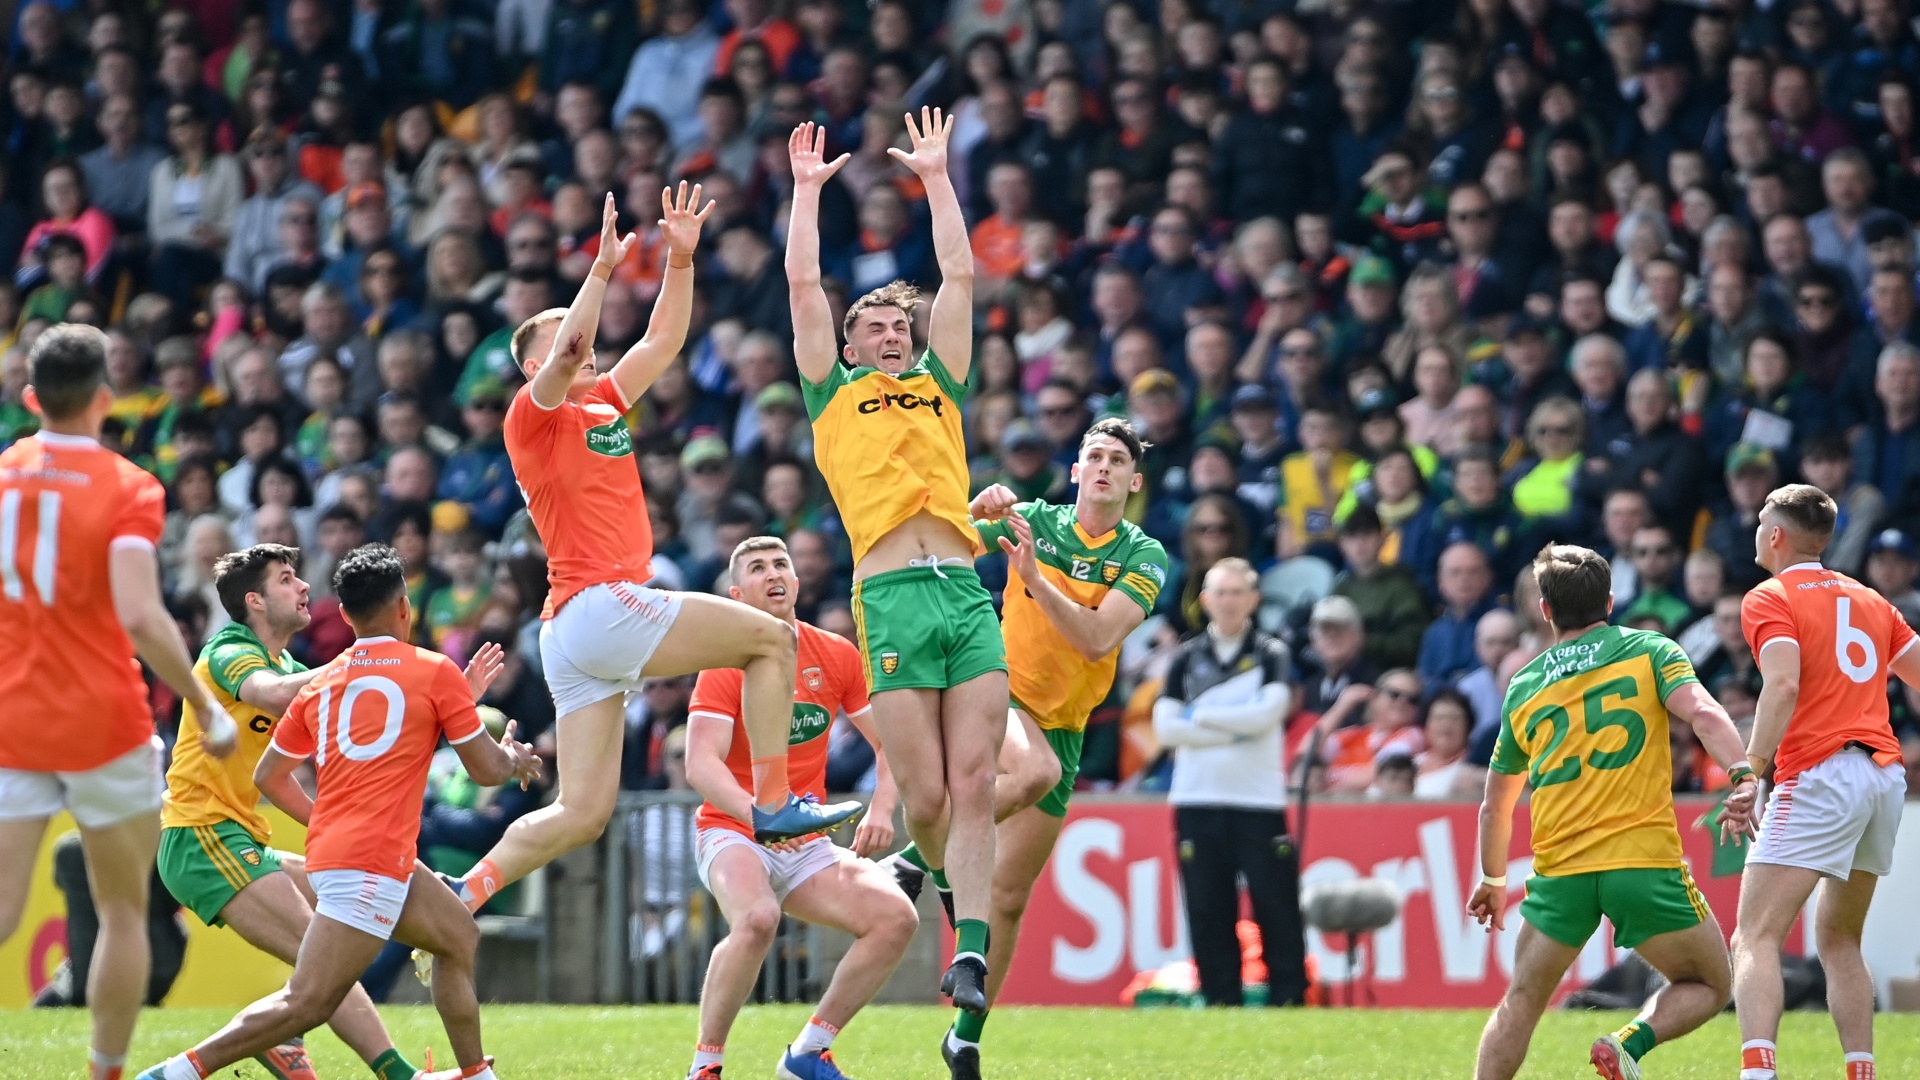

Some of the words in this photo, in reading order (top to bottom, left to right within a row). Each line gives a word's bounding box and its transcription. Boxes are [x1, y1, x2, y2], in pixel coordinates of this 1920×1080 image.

[1071, 560, 1091, 580] 12
[1836, 596, 1878, 683] 6
[316, 675, 406, 767] 10
[1525, 676, 1647, 791] 25
